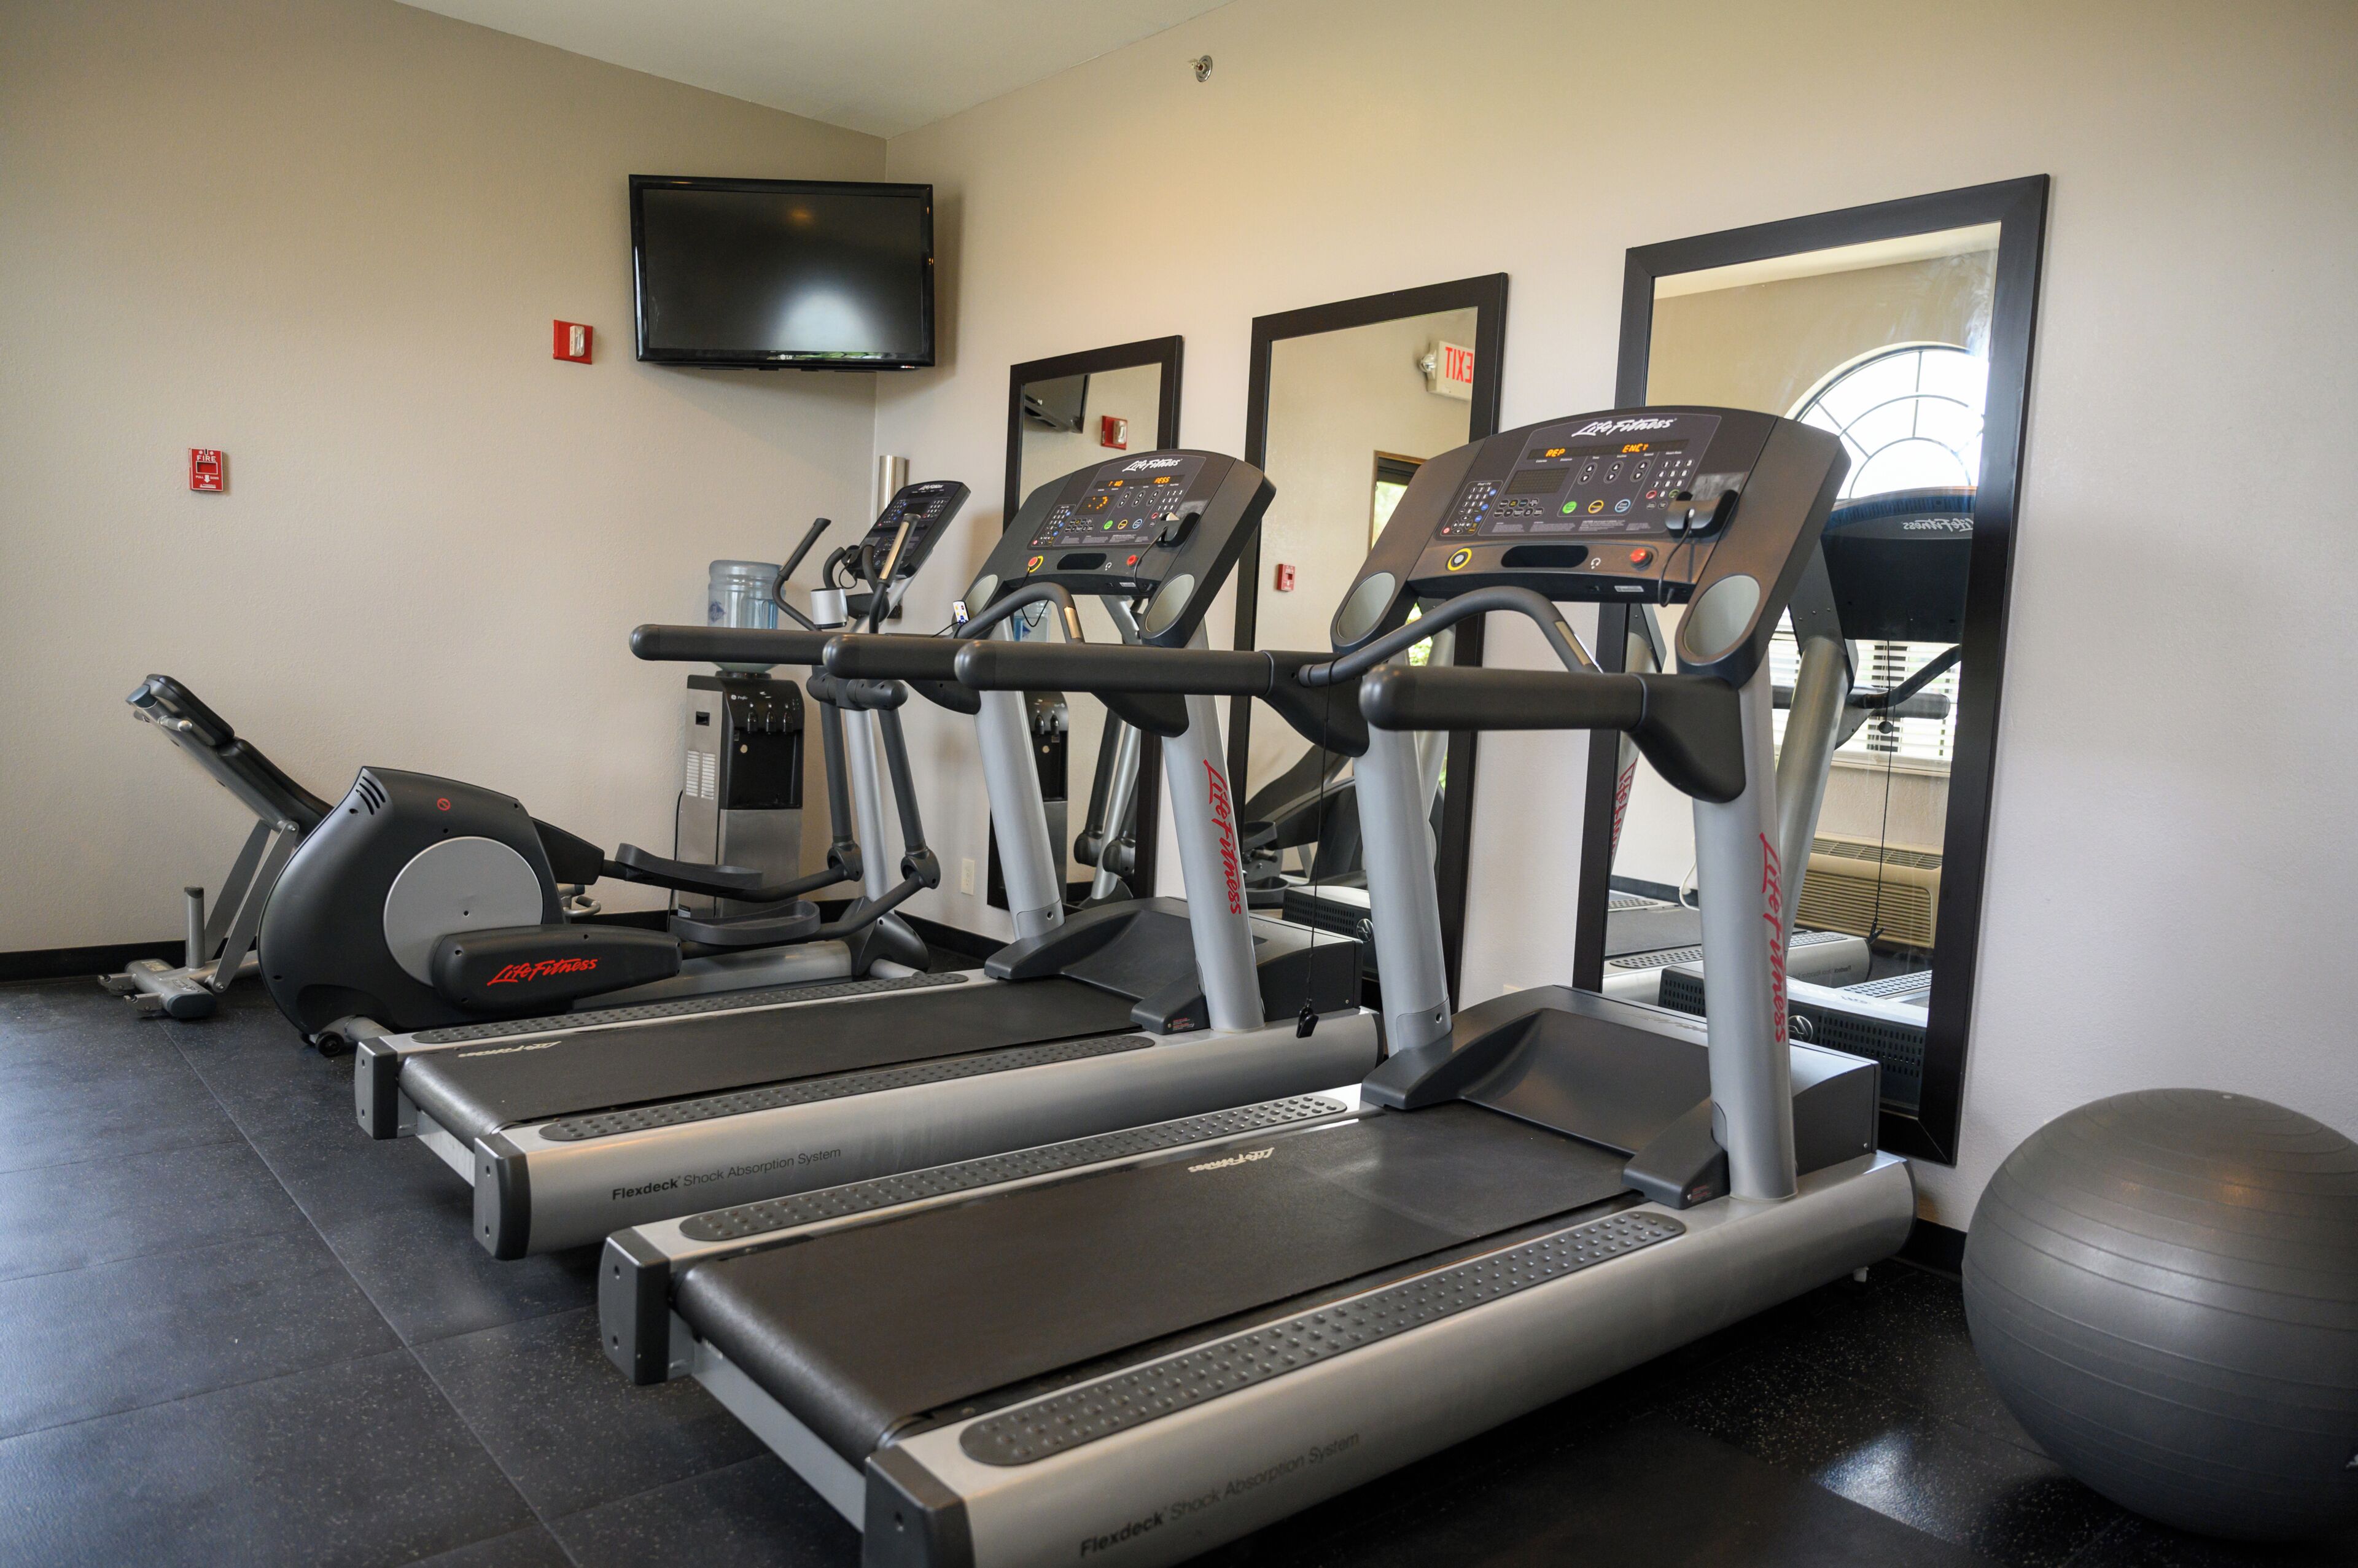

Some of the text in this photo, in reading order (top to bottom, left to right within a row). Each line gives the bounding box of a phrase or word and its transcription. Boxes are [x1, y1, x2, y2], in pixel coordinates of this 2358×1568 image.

[1545, 448, 1566, 457] REP
[612, 1148, 841, 1200] Flexdeck Shock Absorption System
[1080, 1432, 1360, 1558] Flexdeck Shock Absorption System
